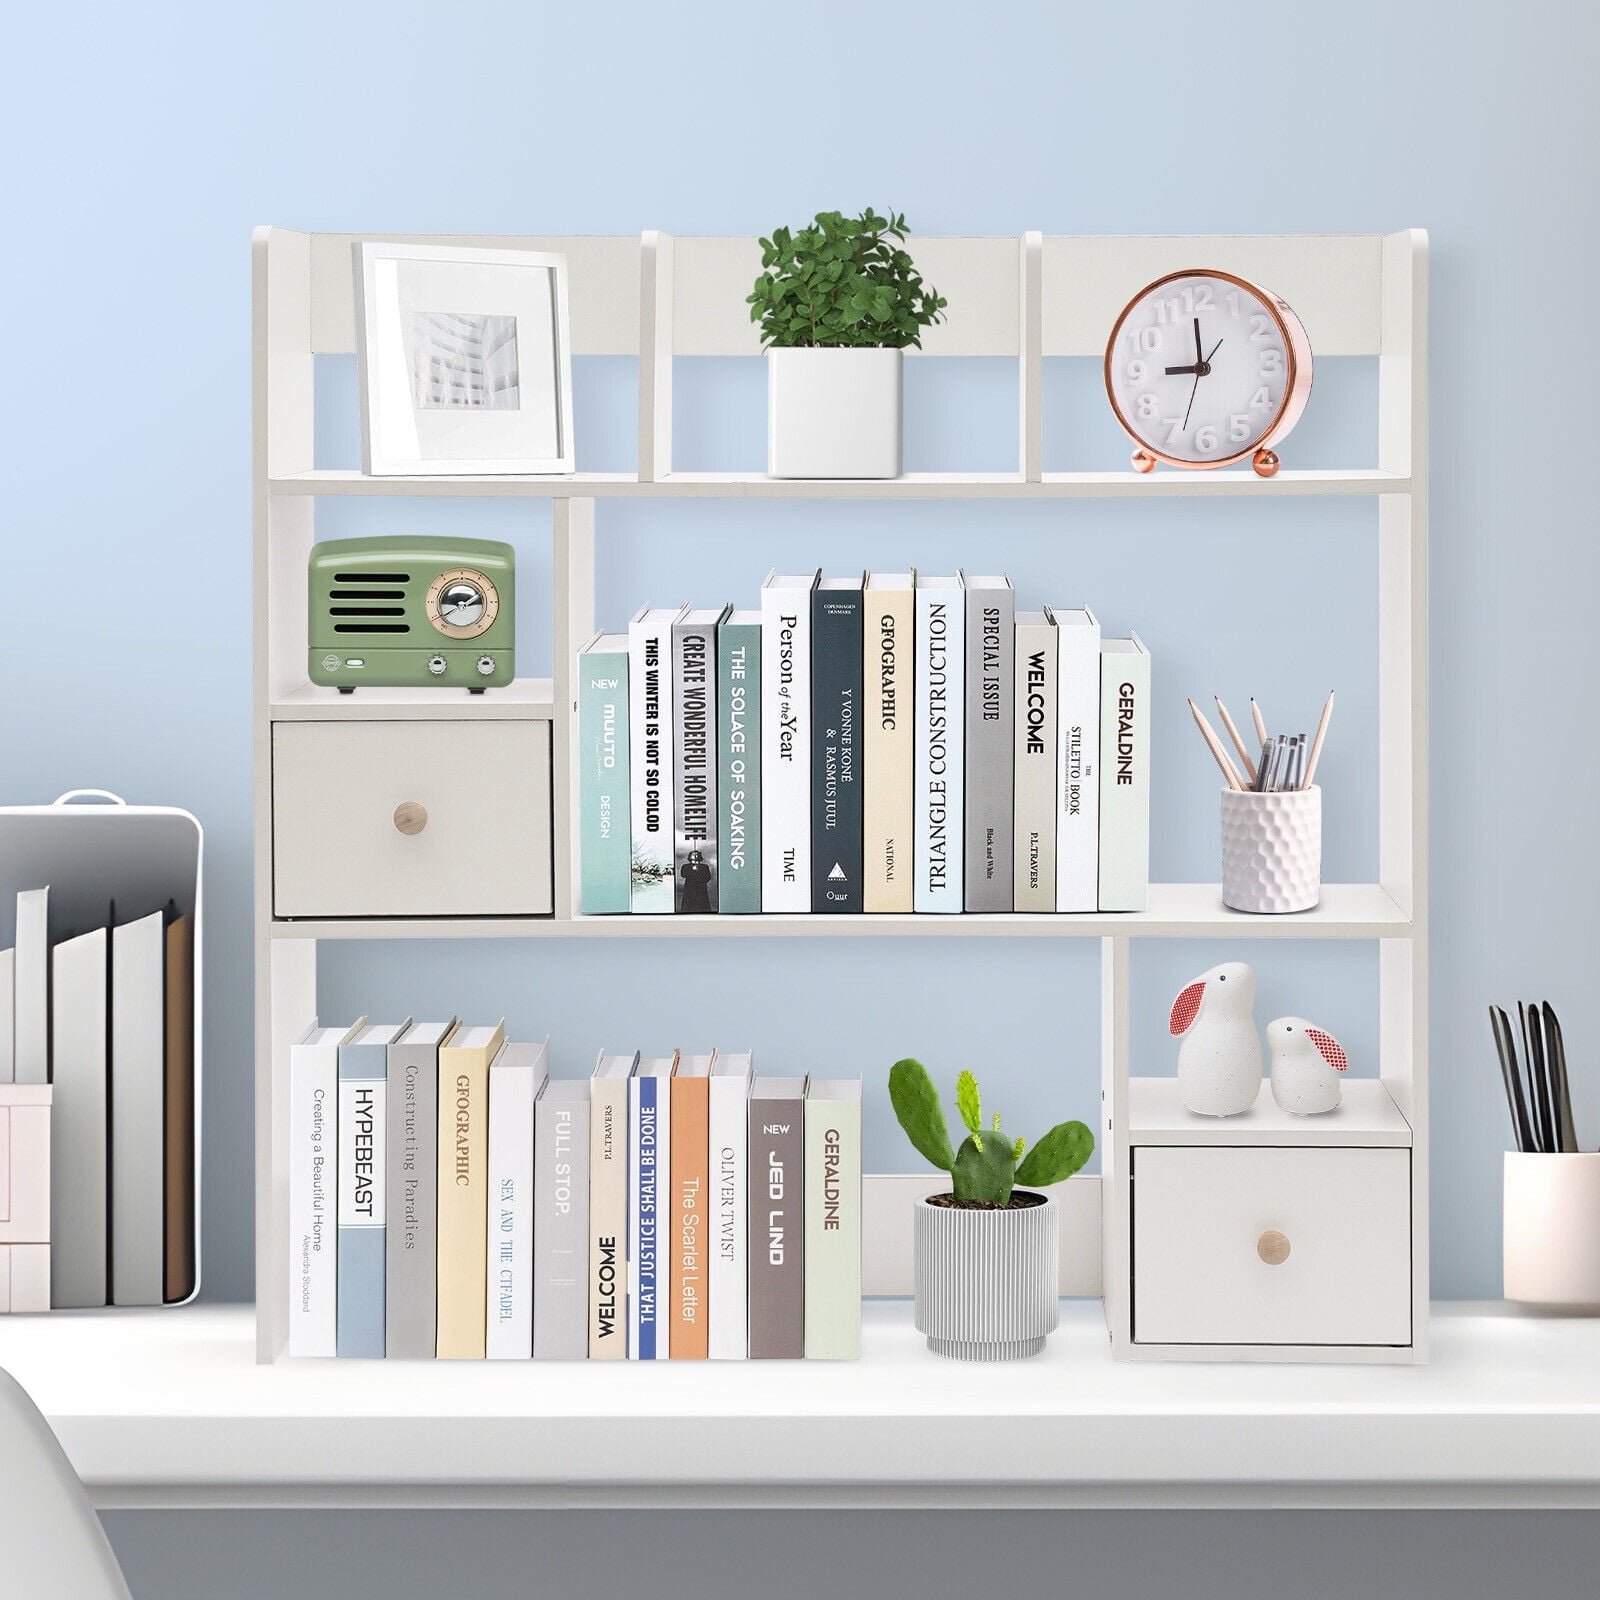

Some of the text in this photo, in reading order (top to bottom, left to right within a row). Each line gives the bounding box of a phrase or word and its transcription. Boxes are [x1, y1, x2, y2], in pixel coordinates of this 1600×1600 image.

[1154, 298, 1180, 323] 11
[1181, 285, 1215, 312] 12
[1227, 291, 1240, 316] 1
[1129, 327, 1161, 352] 10
[1250, 315, 1271, 340] 2
[1127, 360, 1146, 386] 9
[1260, 350, 1282, 376] 3
[1138, 394, 1158, 419] 8
[1250, 387, 1272, 414] 4
[1164, 419, 1184, 443] 7
[1196, 426, 1218, 453] 6
[1231, 415, 1250, 442] 5
[592, 678, 619, 690] NEW
[779, 615, 797, 762] Person of the Year
[881, 615, 895, 730] GFOGRAPHIC
[983, 609, 999, 720] SPECIAL ISSUE
[1028, 651, 1044, 753] WELCOME
[645, 637, 659, 833] THIS WINTER IS NOT SO COLOD
[683, 636, 706, 840] CREATE WONDERFUL HOMELIFE
[730, 645, 746, 869] THE SOLACE OF SOAKING
[930, 604, 946, 892] TRIANGLE CONSTRUCTION
[1118, 683, 1134, 784] GERALDINE
[826, 729, 836, 829] & RASMUS JUUL
[842, 748, 852, 782] KONÉ
[1070, 727, 1081, 815] STILETTO BOOK
[600, 795, 610, 839] DESIGN
[784, 848, 794, 881] TIME
[311, 1089, 324, 1141] Creating
[456, 1075, 469, 1185] GFOGRAPHIC
[764, 1125, 789, 1134] NEW
[355, 1089, 373, 1217] HYPEBEAST
[404, 1066, 418, 1249] Constructing Paradies
[556, 1110, 572, 1216] FULL STOP.
[314, 1157, 324, 1210] Beautiful
[502, 1179, 513, 1201] SEX
[722, 1148, 734, 1261] OLIVER TWIST
[825, 1129, 839, 1230] GERALDINE
[312, 1215, 323, 1251] Home
[501, 1210, 513, 1232] AND
[641, 1107, 655, 1323] THAT JUSTICE SHALL BE DONE
[770, 1151, 783, 1265] JED LIND
[302, 1235, 310, 1274] Alexandra
[501, 1240, 512, 1262] THE
[683, 1177, 699, 1323] The Scarlet Letter
[599, 1237, 615, 1338] WELCOME
